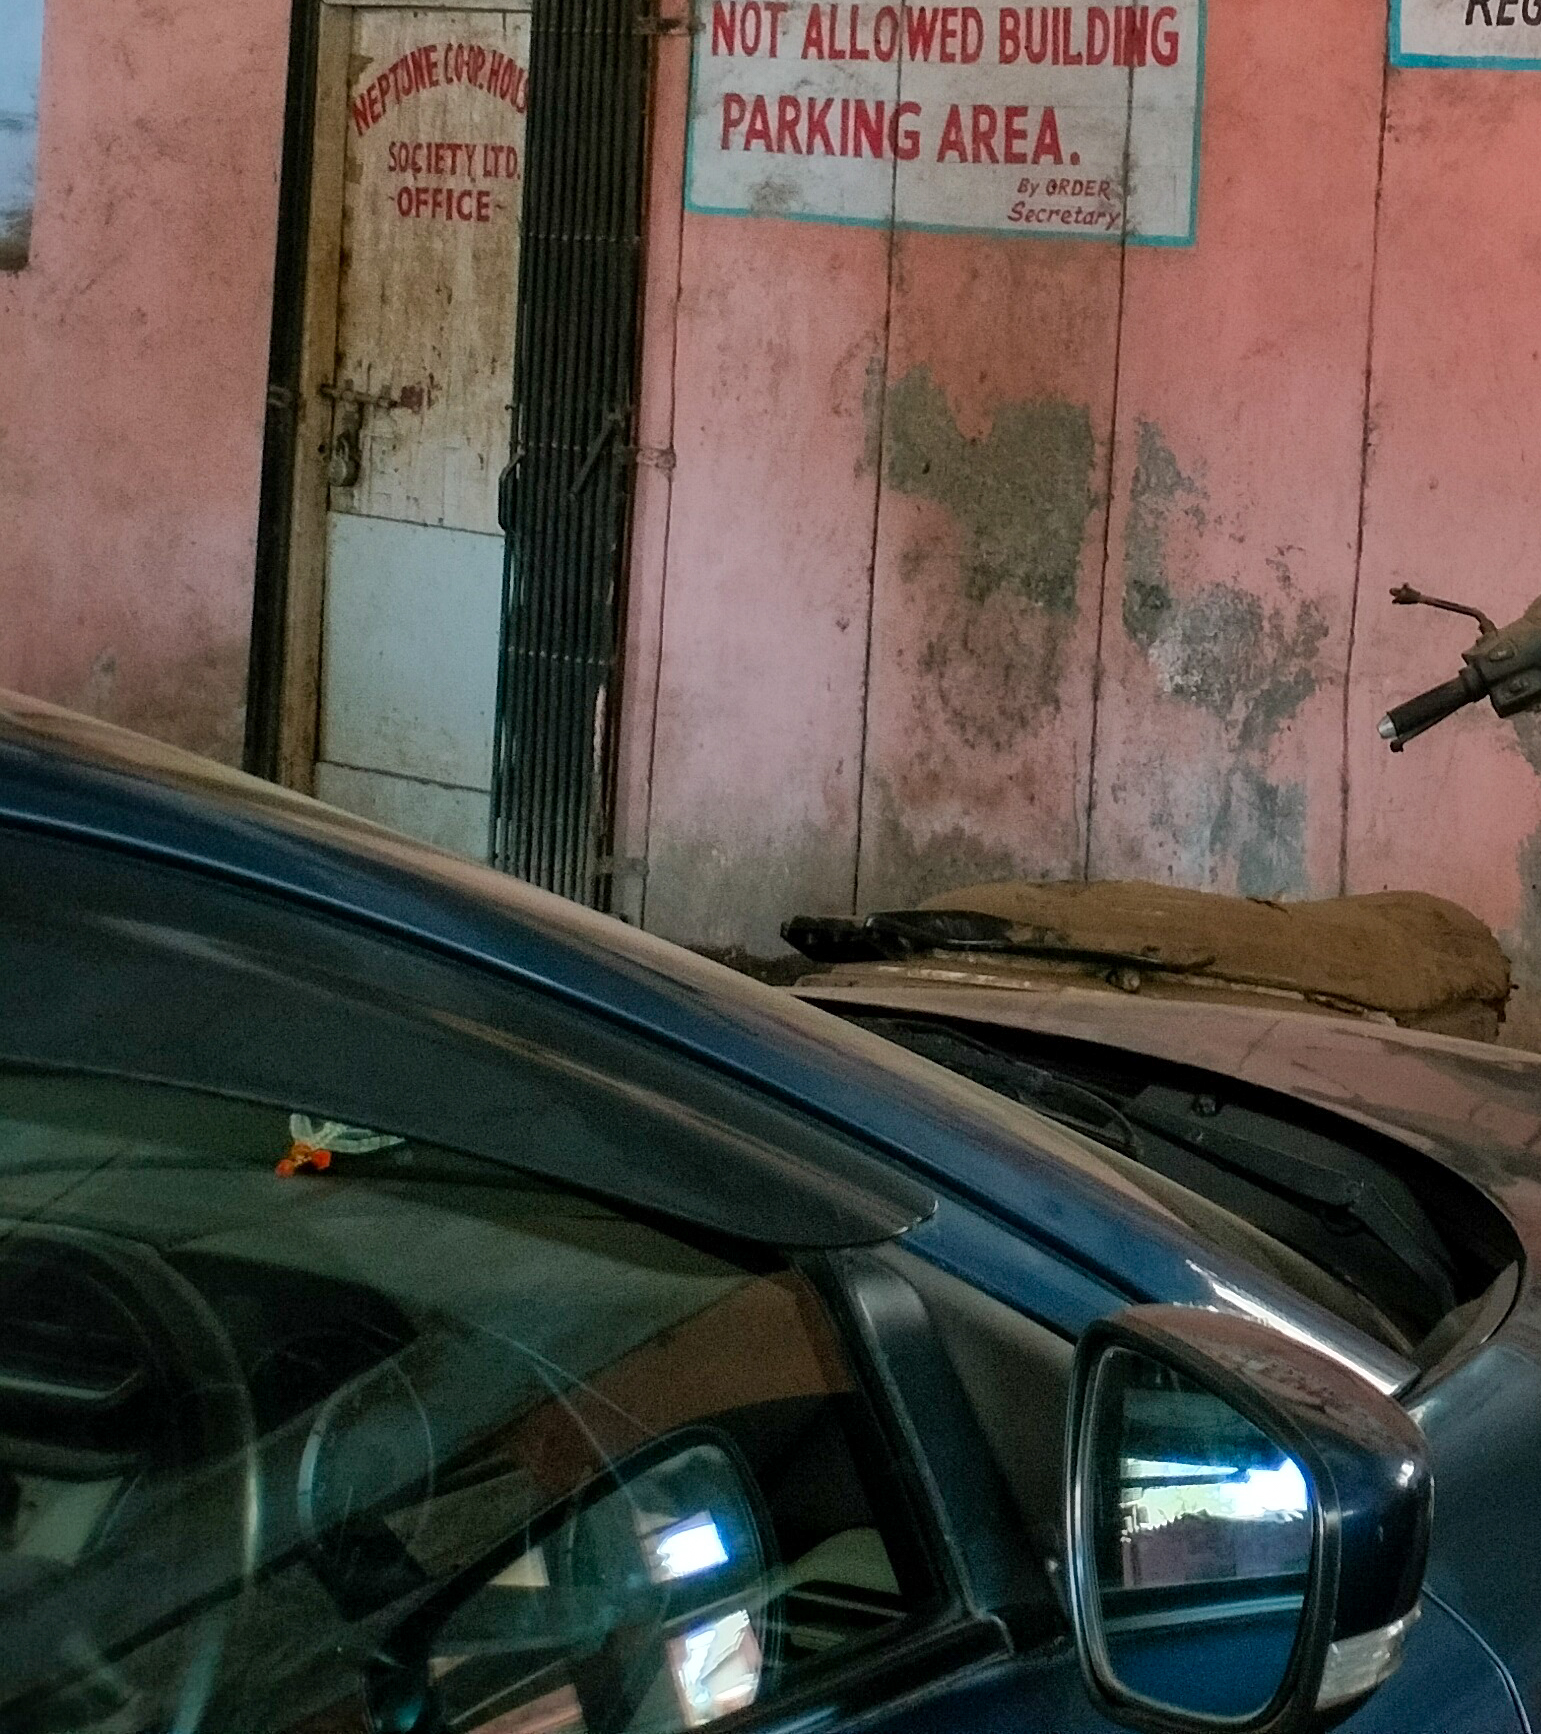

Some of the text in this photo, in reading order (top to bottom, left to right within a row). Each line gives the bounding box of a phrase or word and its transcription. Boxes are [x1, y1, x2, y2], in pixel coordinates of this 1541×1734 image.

[711, 0, 1180, 67] NOT ALLOWED BUILDING
[352, 44, 439, 136] NEPTUNE
[721, 93, 1081, 165] PARKING AREA.
[388, 141, 521, 180] SOCIETY LTD.
[397, 186, 491, 222] OFFICE
[1017, 178, 1112, 200] By ORDER
[1008, 201, 1123, 231] Secretary
